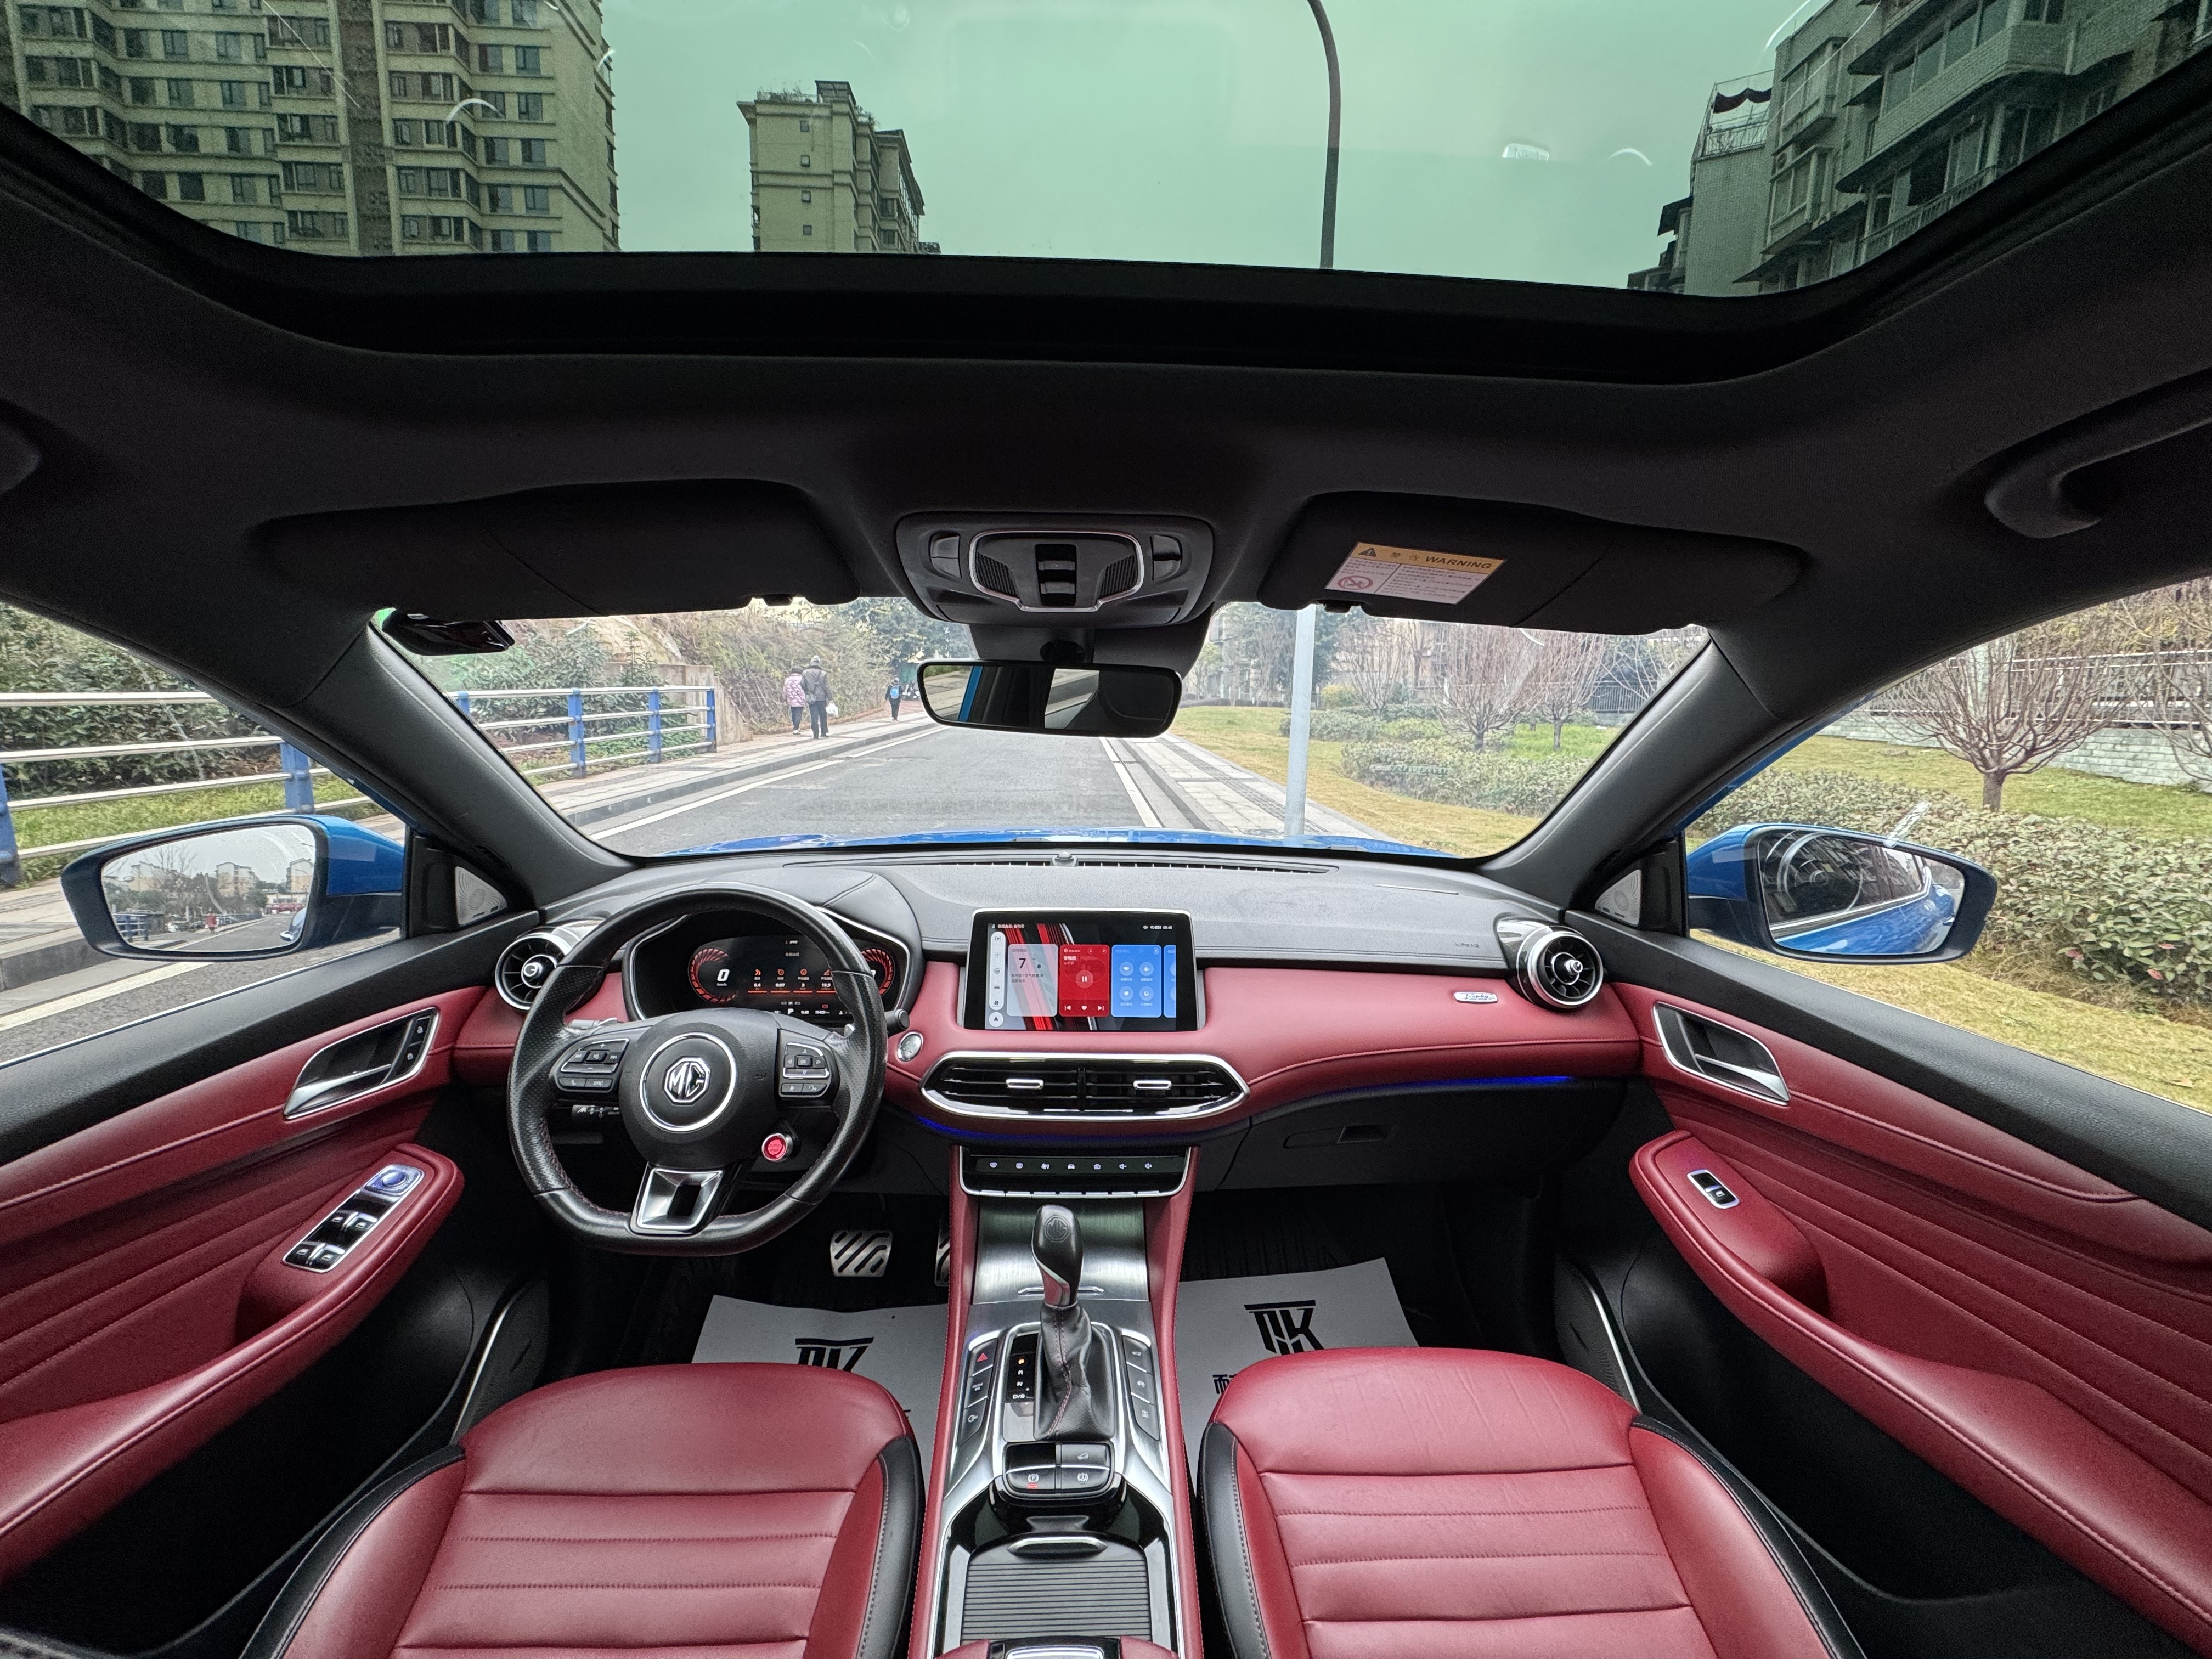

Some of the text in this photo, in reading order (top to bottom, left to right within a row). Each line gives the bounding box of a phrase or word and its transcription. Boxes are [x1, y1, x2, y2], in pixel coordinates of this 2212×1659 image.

[1425, 556, 1492, 569] WARNING
[1019, 957, 1026, 969] 7
[717, 969, 730, 981] 0
[669, 1060, 705, 1099] MG
